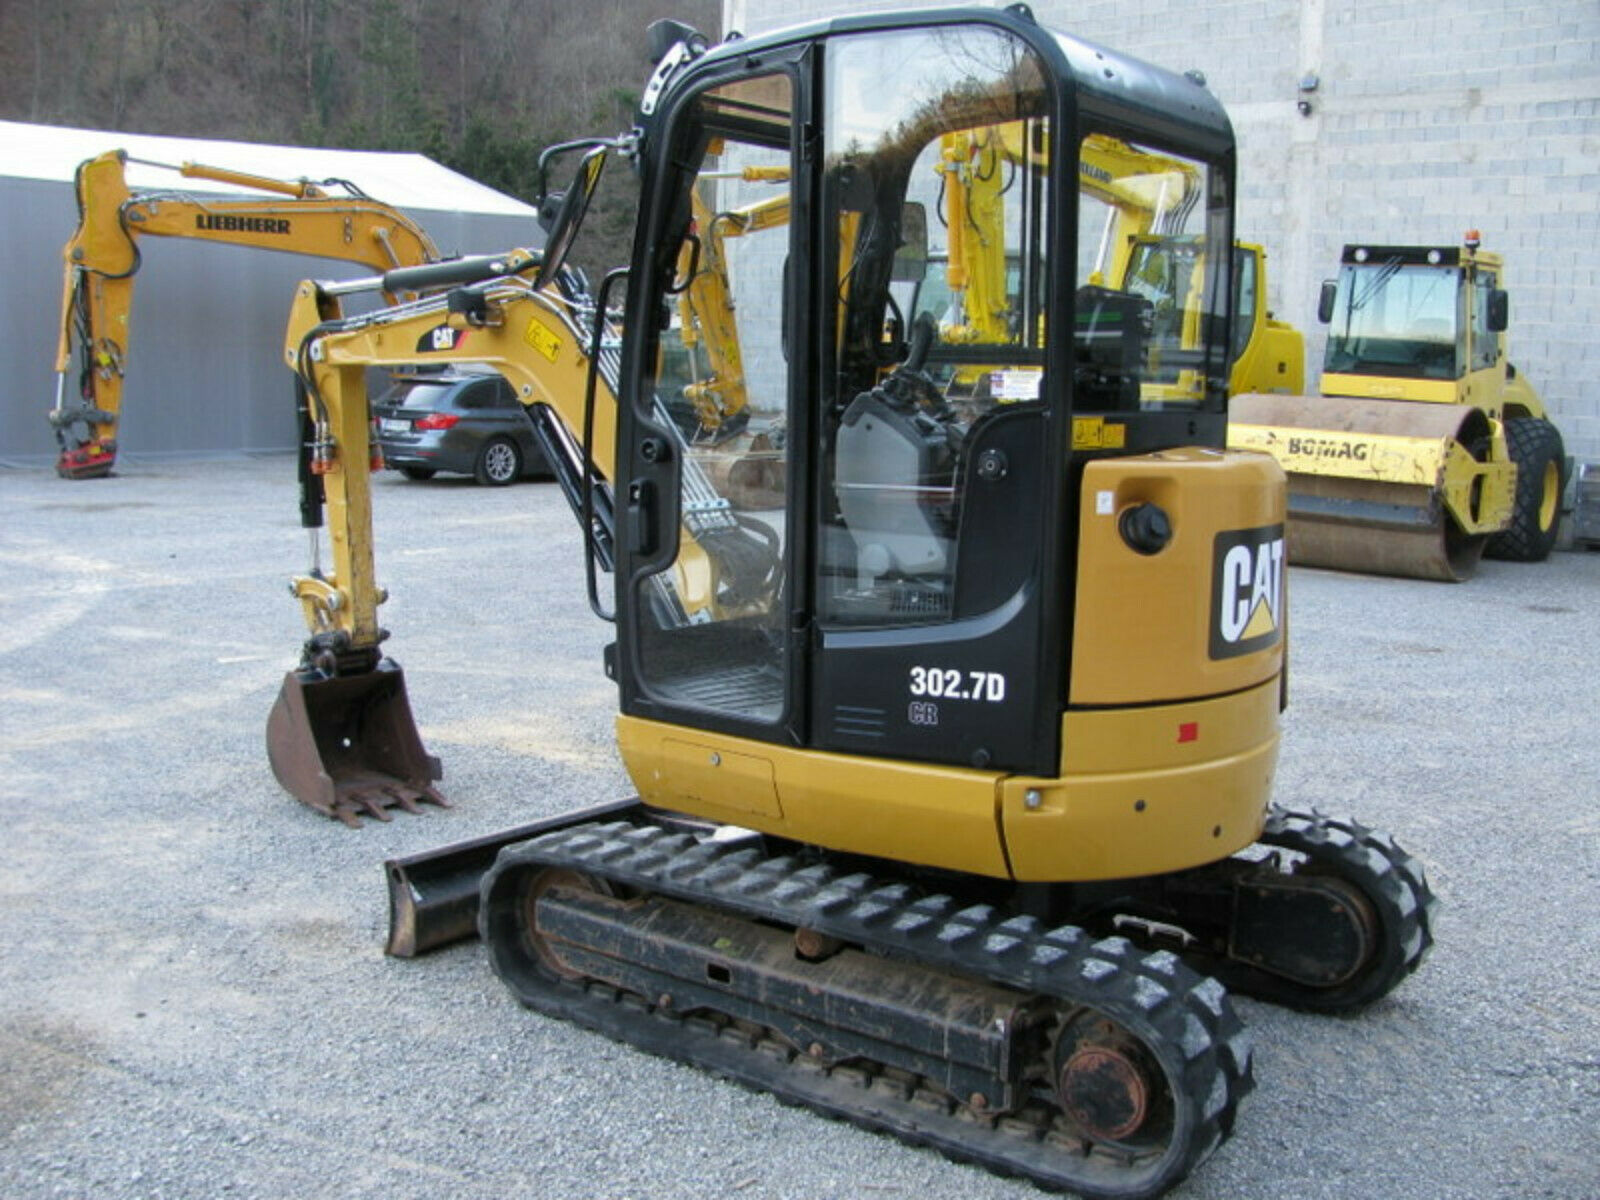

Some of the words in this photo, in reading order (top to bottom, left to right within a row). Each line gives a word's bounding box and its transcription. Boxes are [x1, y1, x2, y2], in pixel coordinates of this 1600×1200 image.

[196, 214, 290, 234] LIEBHERR
[433, 327, 455, 349] CAT
[1288, 437, 1368, 461] BOMAG
[1221, 539, 1283, 643] CAT
[910, 665, 1005, 701] 302.7D
[908, 701, 939, 725] CR
